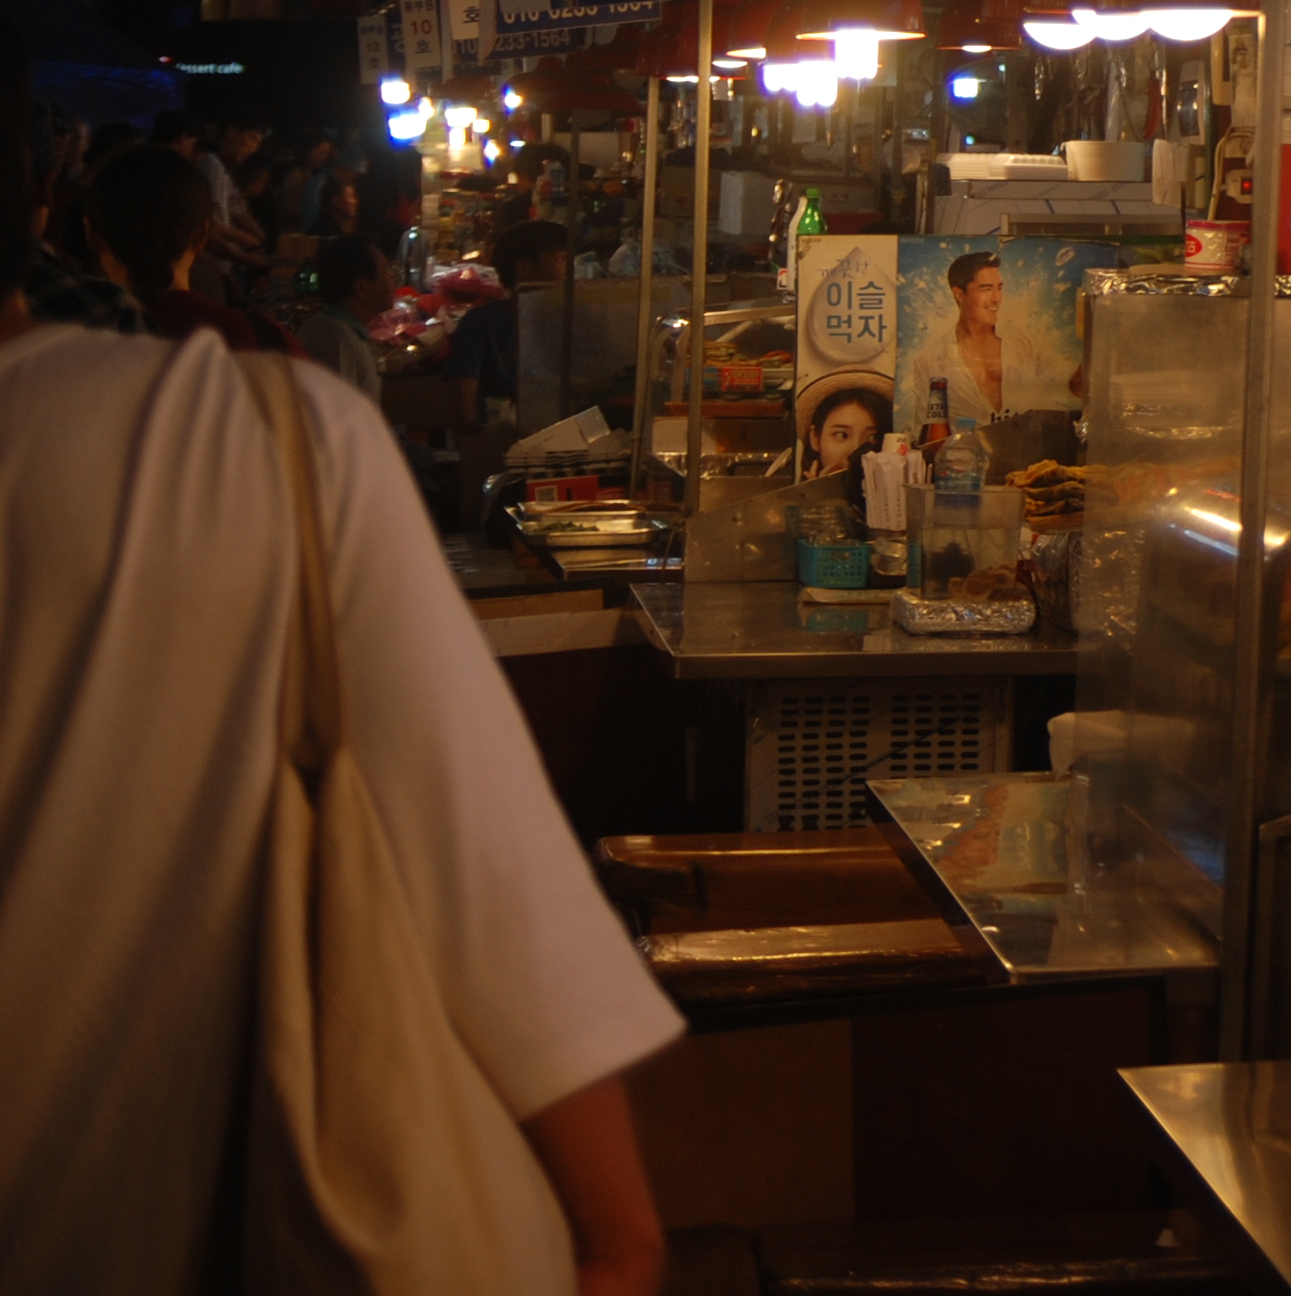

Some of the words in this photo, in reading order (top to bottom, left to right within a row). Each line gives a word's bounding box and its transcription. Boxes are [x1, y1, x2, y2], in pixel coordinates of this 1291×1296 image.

[410, 19, 433, 36] 10
[414, 39, 433, 55] 호
[825, 281, 887, 311] 이슬
[825, 313, 888, 344] 먹자
